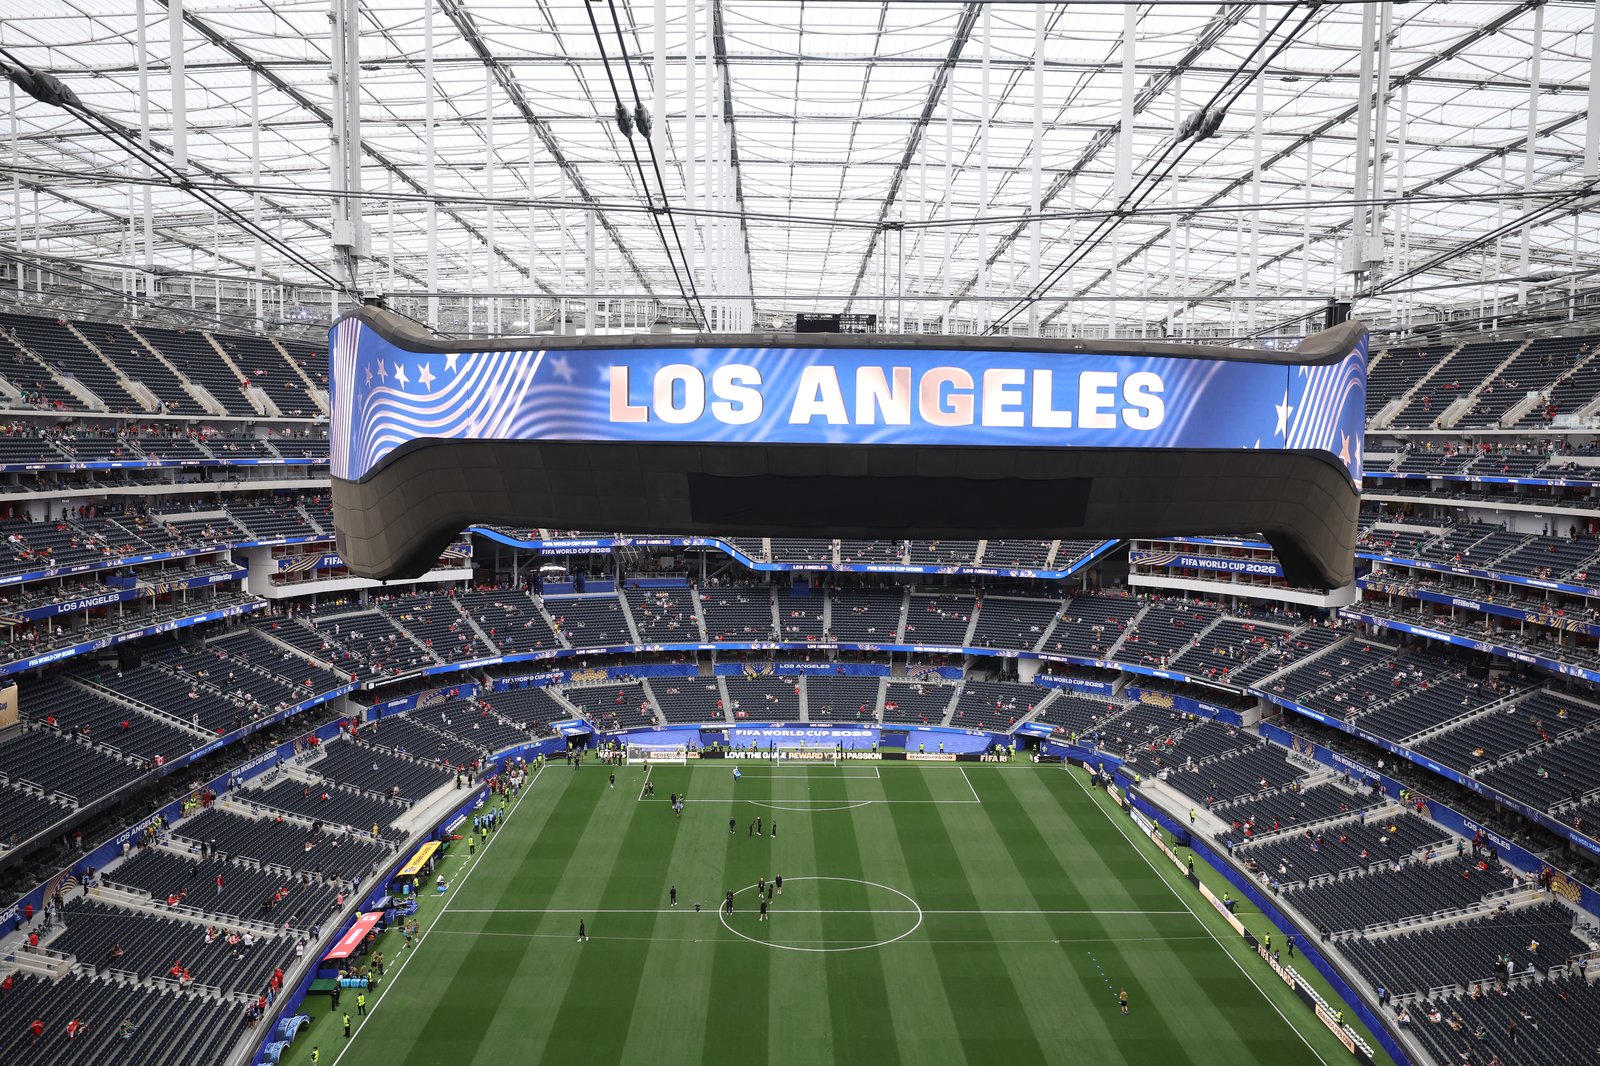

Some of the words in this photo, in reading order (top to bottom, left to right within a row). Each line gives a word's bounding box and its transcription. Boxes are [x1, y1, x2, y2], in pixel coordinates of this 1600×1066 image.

[609, 364, 764, 425] LOS
[788, 365, 1165, 431] ANGELES
[324, 557, 343, 566] FIFA
[1181, 558, 1198, 567] FIFA
[1199, 559, 1228, 569] WORLD
[1228, 562, 1245, 571] CUP
[1246, 564, 1277, 574] 2026
[58, 602, 77, 613] LOS
[79, 593, 120, 609] ANGELES
[1085, 681, 1104, 689] 2026
[736, 729, 761, 737] FIFA
[764, 729, 806, 737] WORLD
[807, 729, 830, 737] CUP
[831, 729, 872, 737] 2026
[724, 751, 744, 759] LOVE
[847, 752, 882, 760] PASSION
[980, 754, 999, 762] FIFA
[1463, 819, 1477, 832] LOS
[116, 832, 130, 845] LOS
